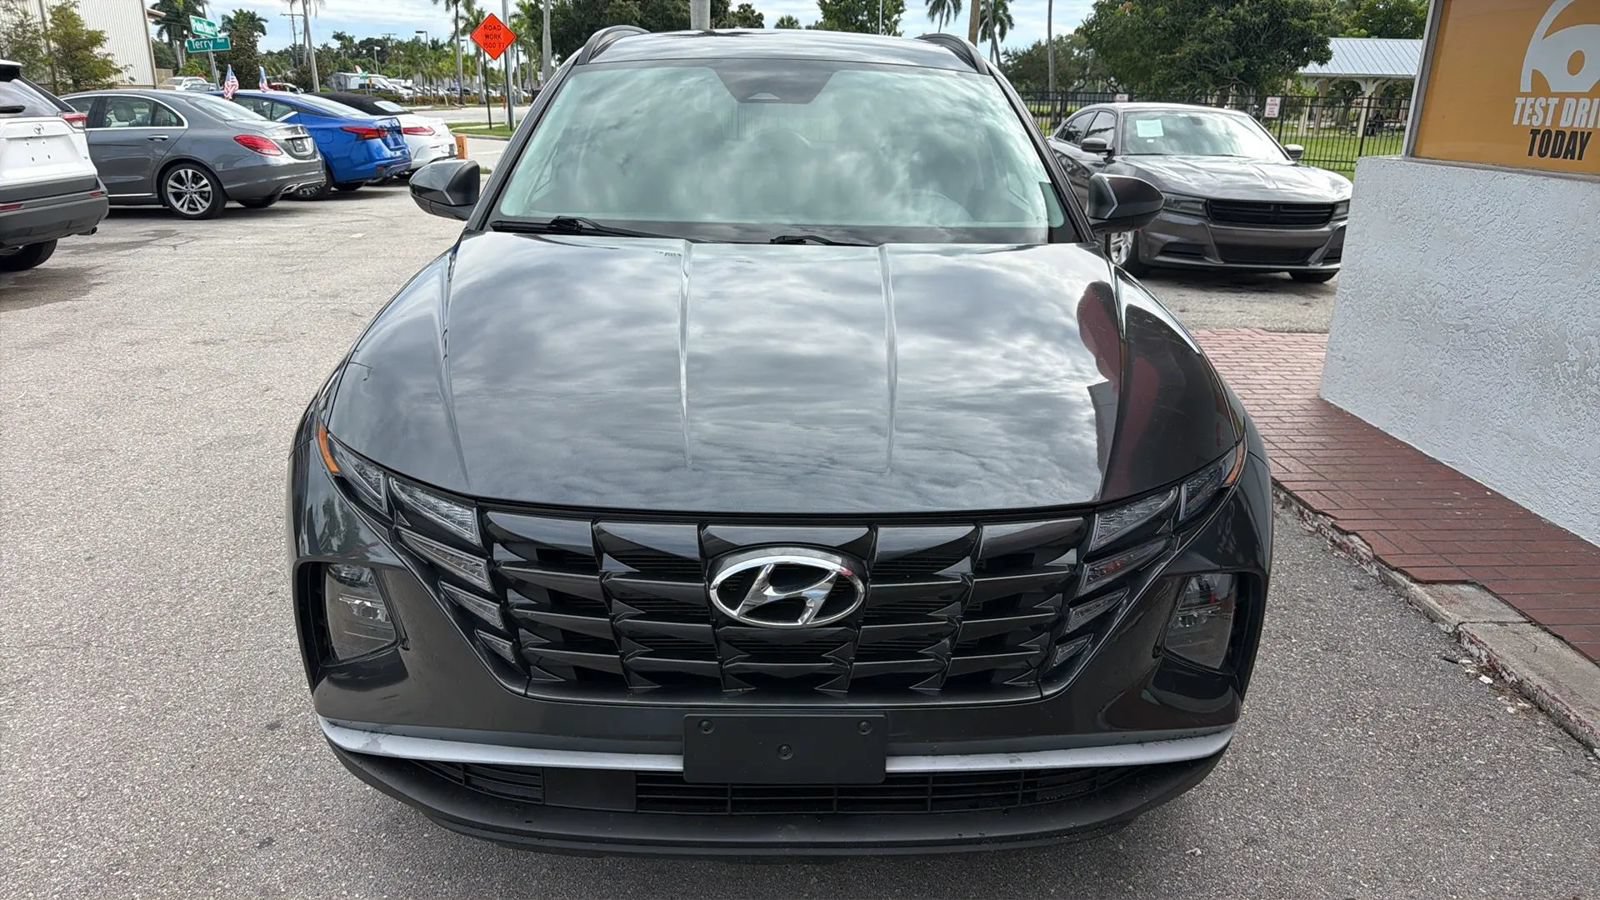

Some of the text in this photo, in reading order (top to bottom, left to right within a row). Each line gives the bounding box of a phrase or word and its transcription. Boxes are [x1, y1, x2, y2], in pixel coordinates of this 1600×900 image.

[191, 39, 213, 50] Terry
[1513, 97, 1560, 127] TEST
[1528, 128, 1592, 161] TODAY
